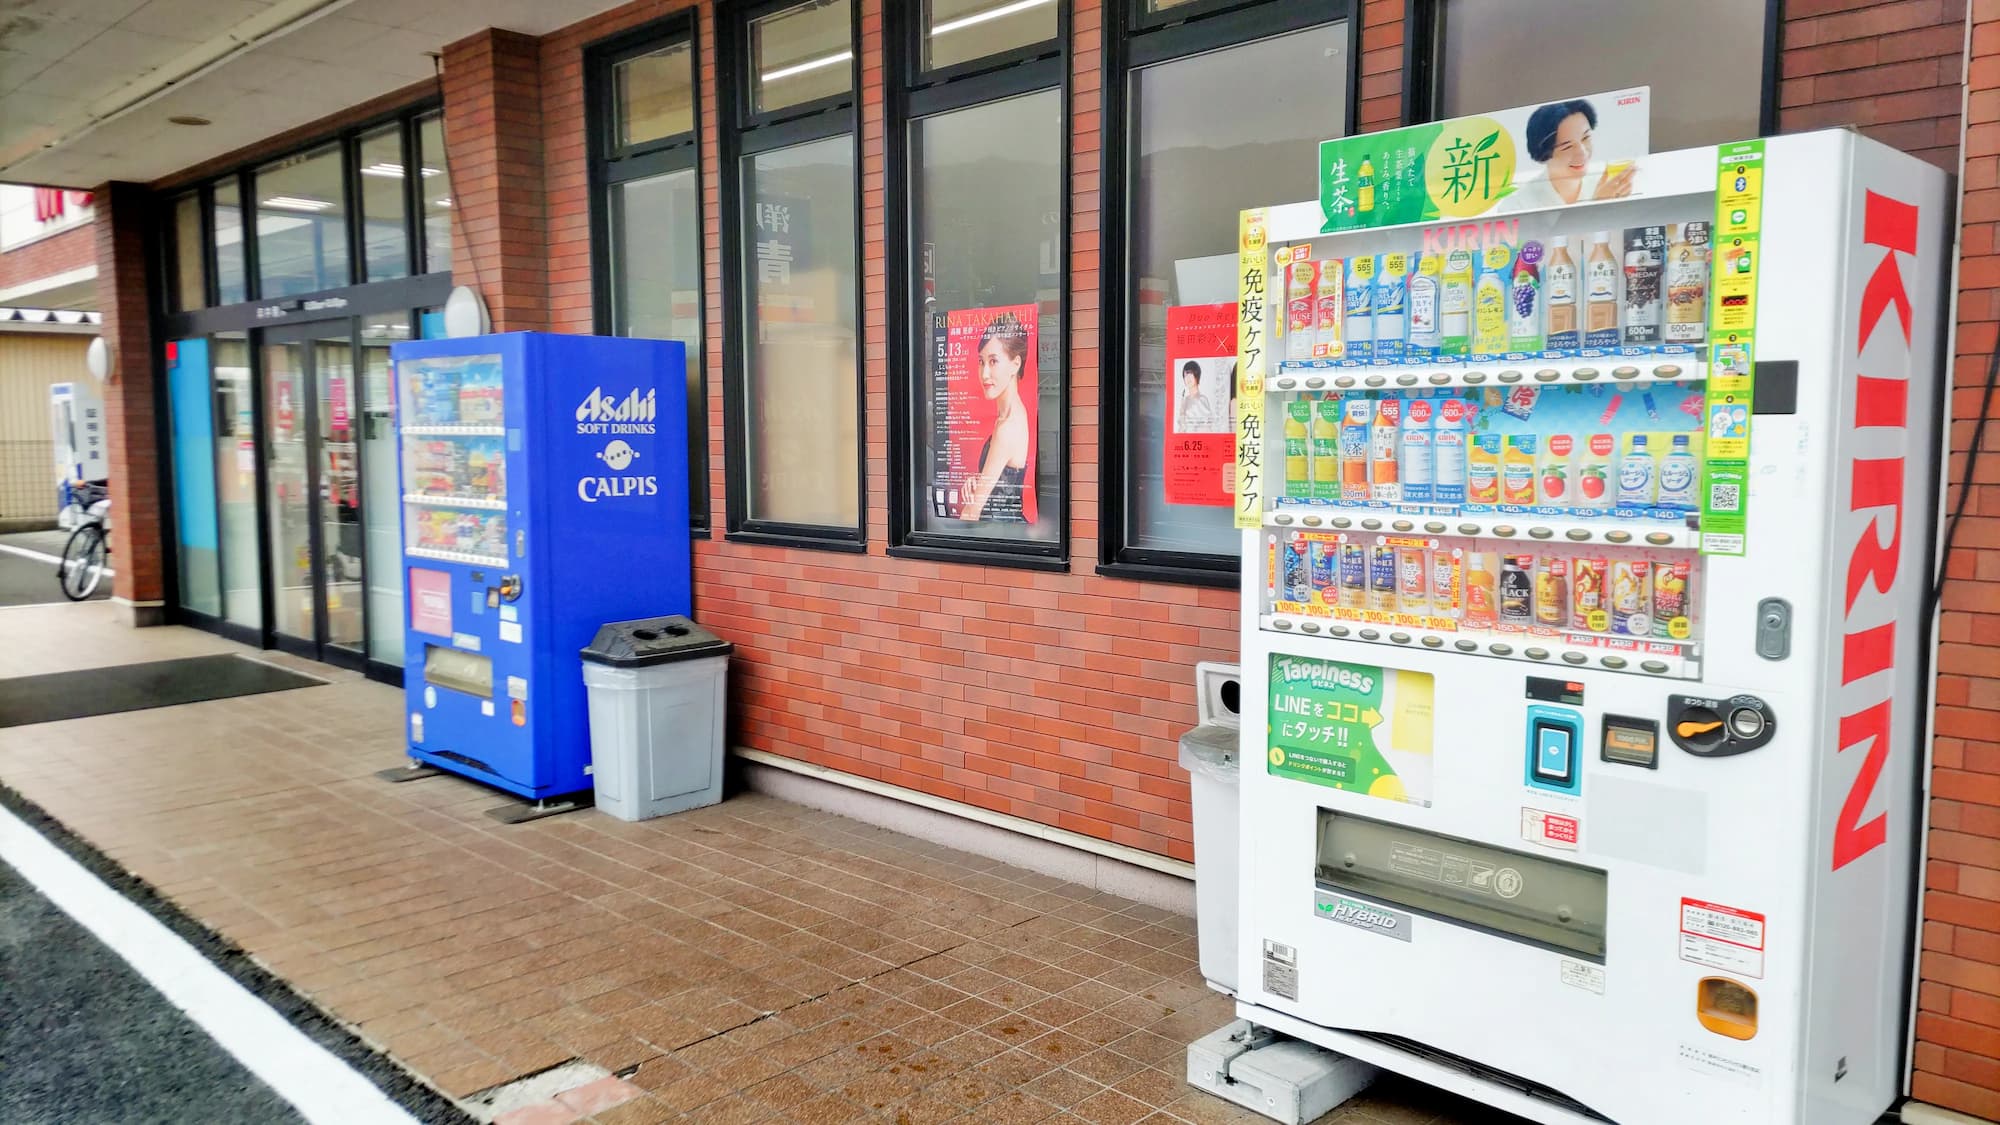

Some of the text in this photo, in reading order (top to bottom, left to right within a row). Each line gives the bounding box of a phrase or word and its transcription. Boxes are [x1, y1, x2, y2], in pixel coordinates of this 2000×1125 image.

[1617, 96, 1641, 106] KIRIN
[1441, 130, 1501, 204] 新
[1330, 158, 1354, 214] 生茶
[1423, 217, 1520, 254] KIRIN
[936, 308, 1034, 329] RINA TAKAHASHI
[1241, 268, 1264, 370] 免疫ケア
[1628, 326, 1654, 334] 600ml
[937, 342, 962, 358] 5.13
[575, 386, 656, 422] Asahi
[1383, 407, 1398, 416] 555
[577, 423, 656, 435] SOFT DRINKS
[1184, 440, 1203, 451] 6.25
[1239, 413, 1261, 513] 免疫ケア
[578, 476, 658, 502] CALPIS
[1830, 187, 1920, 873] KIRIN
[1280, 602, 1295, 611] 100
[1307, 605, 1323, 614] 100
[1337, 608, 1353, 617] 100
[1366, 611, 1383, 620] 100
[1397, 614, 1414, 624] 100
[1430, 618, 1446, 627] 100
[1279, 658, 1375, 695] Tappiness
[1274, 693, 1359, 724] LINEをココ
[1332, 904, 1397, 929] HYBRID
